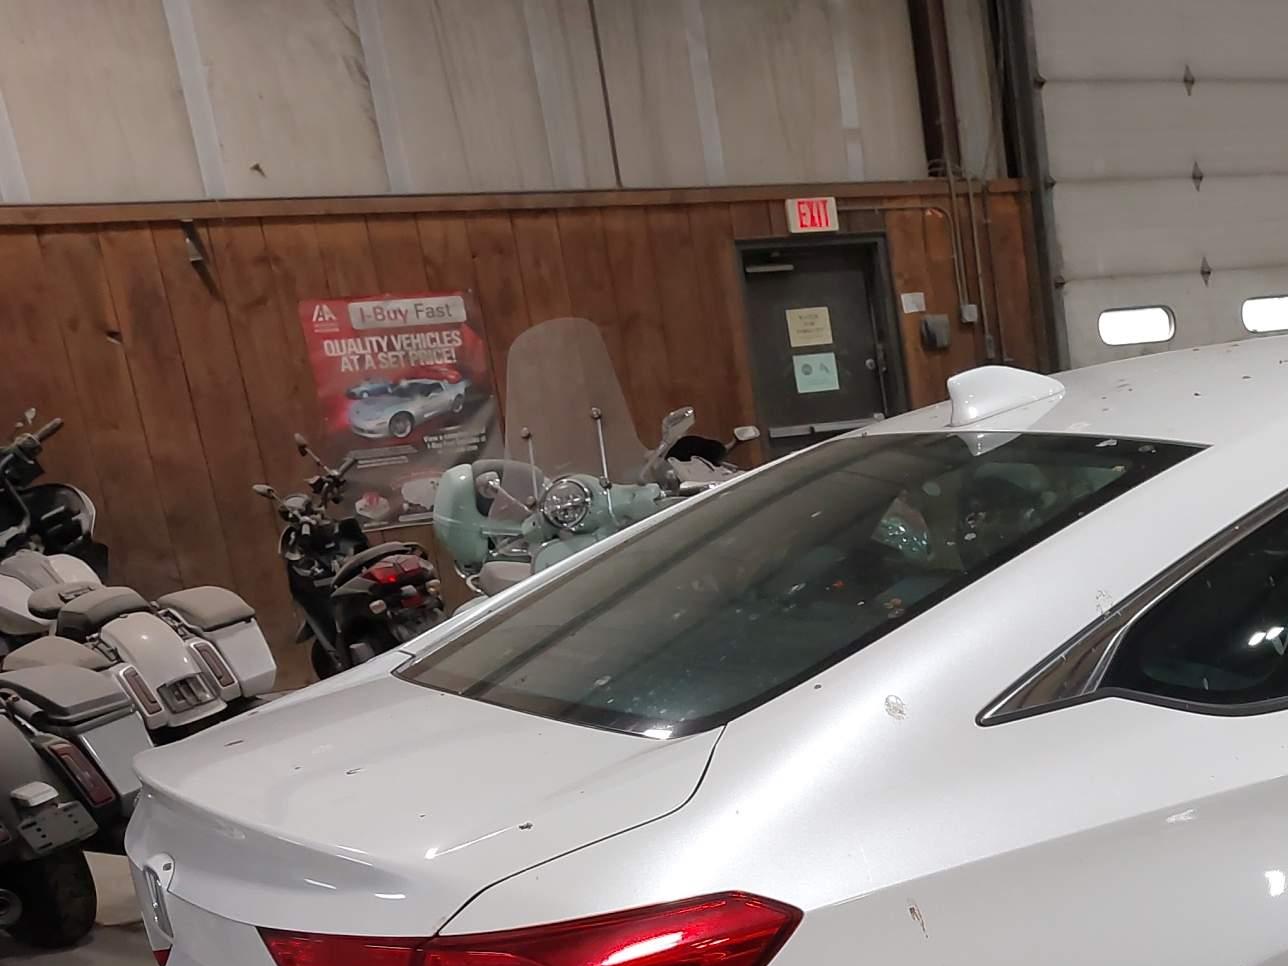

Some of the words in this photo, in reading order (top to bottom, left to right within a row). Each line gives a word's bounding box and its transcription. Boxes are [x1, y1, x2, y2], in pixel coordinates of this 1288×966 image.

[797, 200, 831, 228] EXIT
[360, 306, 409, 322] I-Buy
[414, 303, 453, 319] Fast
[323, 336, 389, 356] QUALITY
[389, 330, 462, 349] VEHICLES
[341, 355, 363, 372] AT
[365, 354, 377, 370] A
[378, 352, 406, 369] SET
[409, 348, 457, 366] PRICE!
